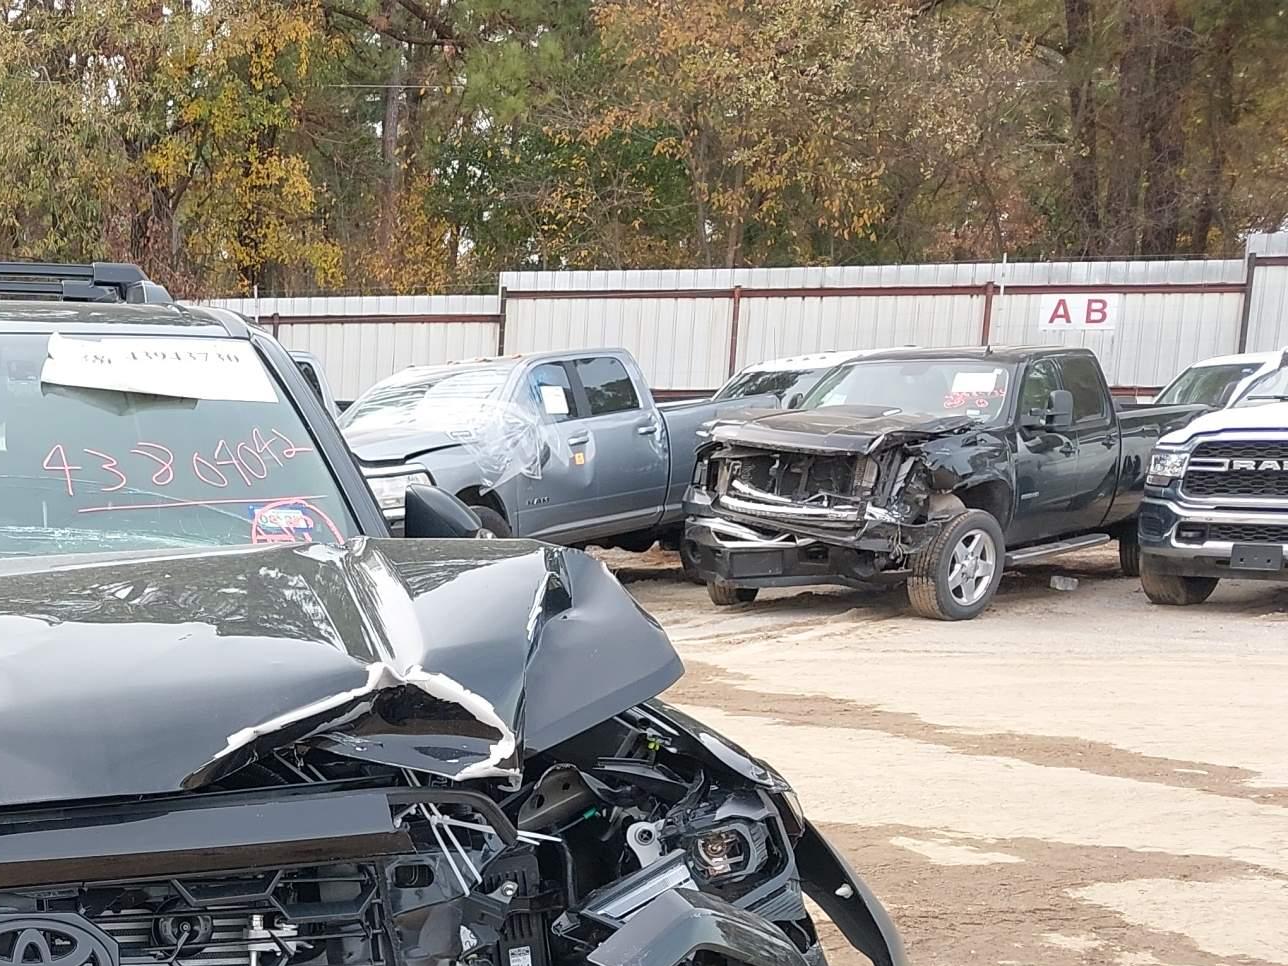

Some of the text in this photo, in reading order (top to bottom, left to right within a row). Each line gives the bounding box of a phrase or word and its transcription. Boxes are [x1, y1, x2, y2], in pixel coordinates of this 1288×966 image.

[1048, 299, 1108, 324] A B
[1233, 460, 1288, 471] RA
